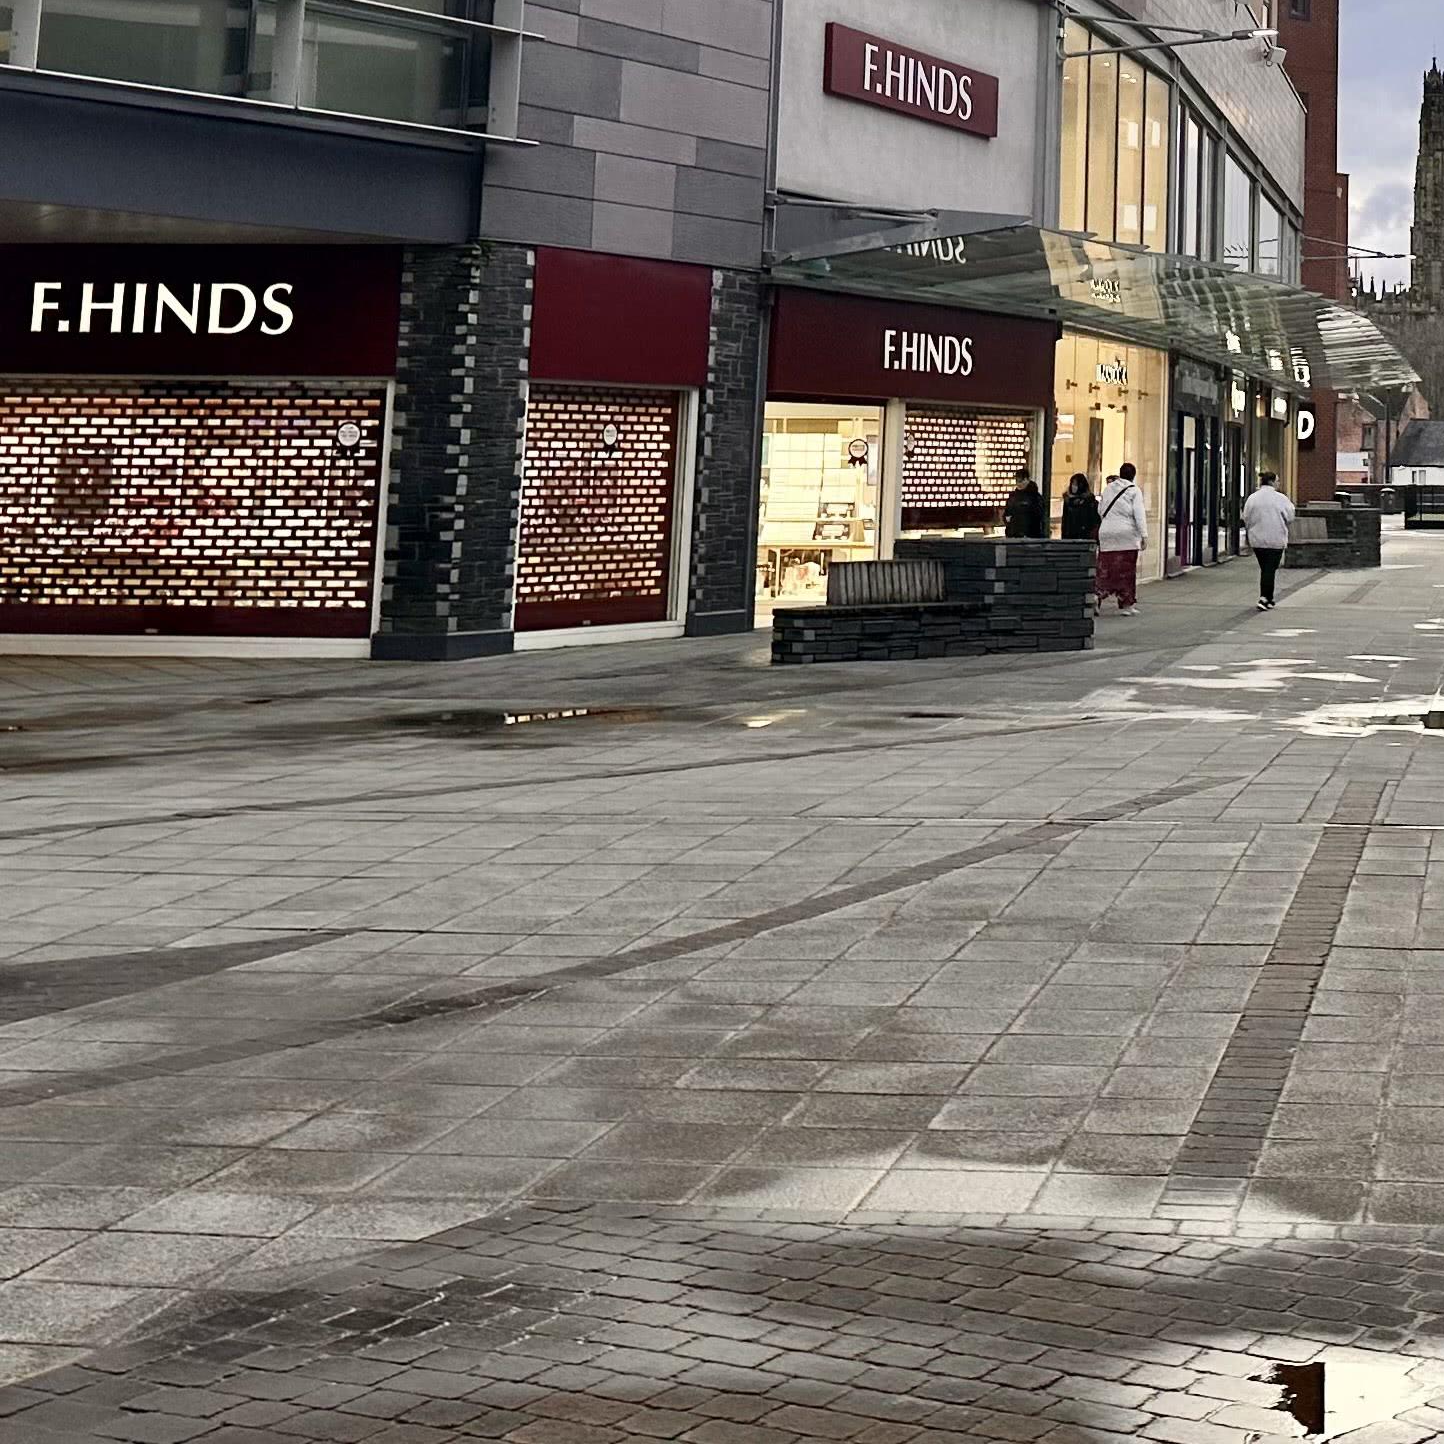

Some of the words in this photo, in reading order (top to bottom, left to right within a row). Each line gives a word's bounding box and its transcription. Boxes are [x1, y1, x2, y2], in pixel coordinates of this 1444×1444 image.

[862, 42, 974, 121] F.HINDS
[30, 282, 294, 336] F.HINDS
[883, 329, 974, 377] F.HINDS
